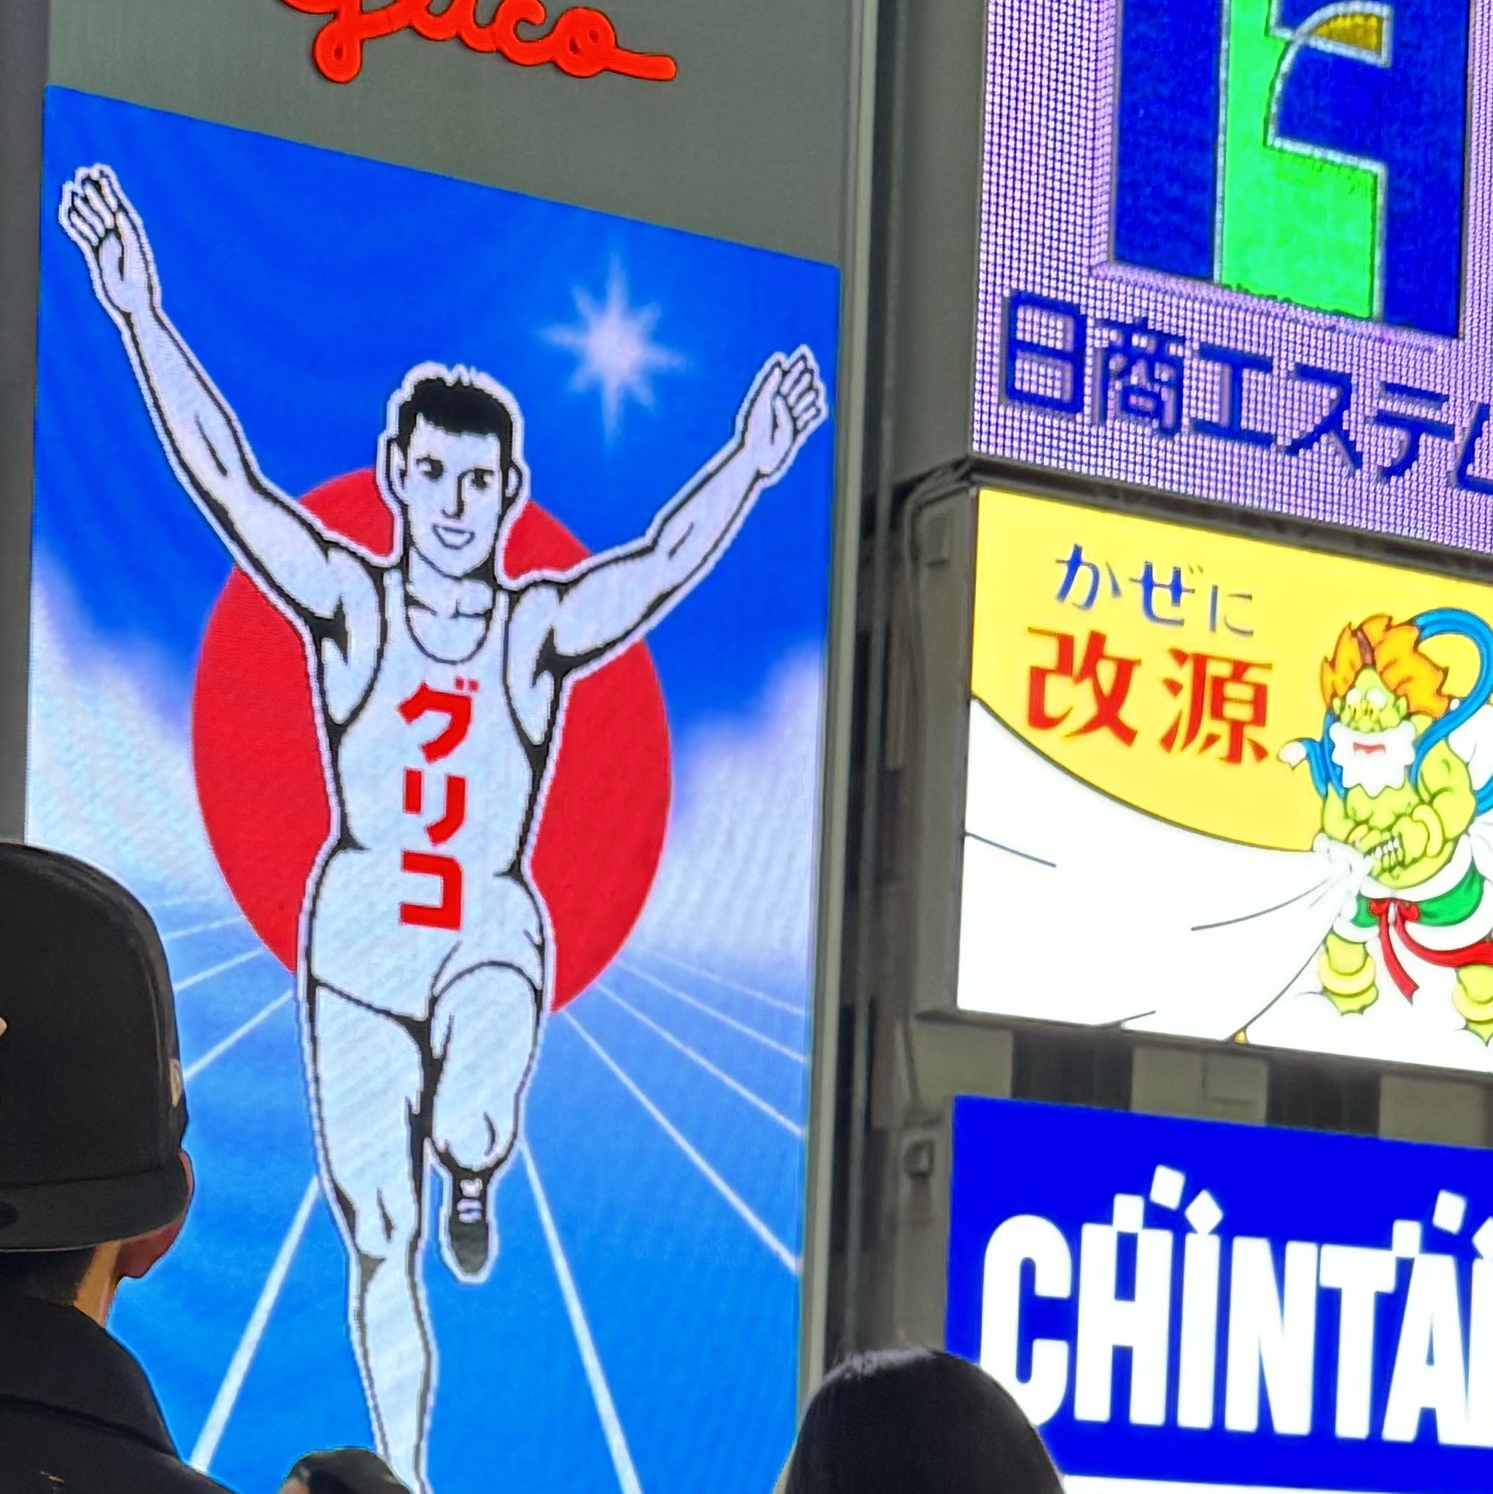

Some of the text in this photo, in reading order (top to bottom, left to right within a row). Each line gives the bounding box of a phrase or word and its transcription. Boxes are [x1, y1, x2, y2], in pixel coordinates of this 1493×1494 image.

[1055, 543, 1254, 637] かぜに
[1026, 627, 1274, 765] 改源
[395, 677, 480, 932] グリコ
